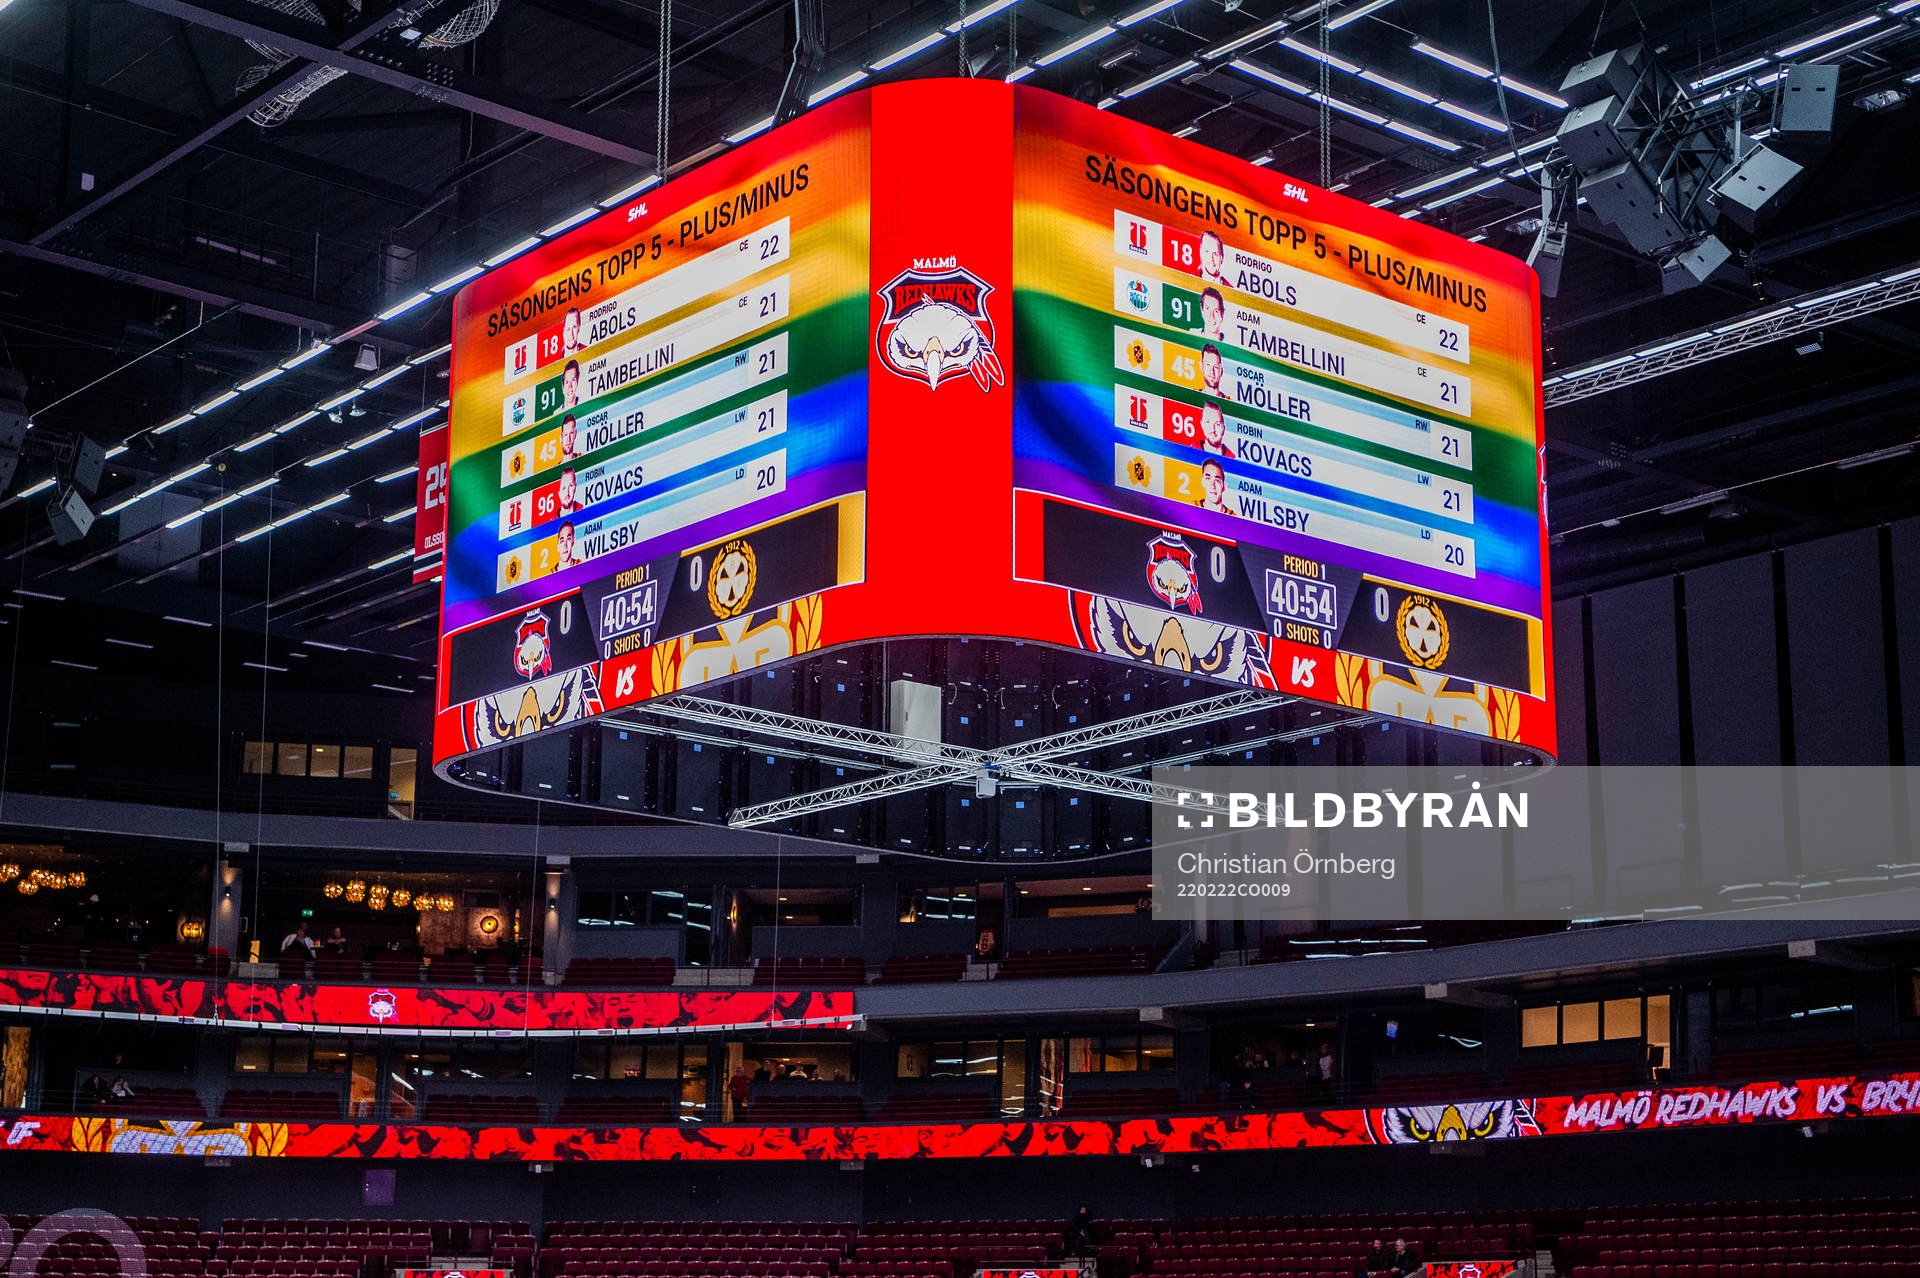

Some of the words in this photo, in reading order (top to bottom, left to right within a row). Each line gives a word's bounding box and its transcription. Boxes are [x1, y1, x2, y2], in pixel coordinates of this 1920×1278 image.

[1084, 155, 1238, 229] SÄSONGENS
[1244, 209, 1307, 251] TOPP
[1314, 235, 1327, 260] 5
[1348, 244, 1487, 312] PLUS/MINUS
[487, 268, 592, 337] SÄSONGENS
[596, 242, 646, 286] TOPP
[651, 234, 662, 260] 5
[679, 164, 809, 248] PLUS/MINUS
[739, 239, 749, 252] CE
[760, 235, 779, 260] 22
[1170, 239, 1193, 265] 18
[913, 256, 957, 269] MALMÖ
[1235, 254, 1272, 274] RODRIGO
[894, 283, 977, 315] REDHAWKS
[1237, 271, 1297, 306] ABOLS
[589, 301, 618, 321] RODRIGO
[738, 296, 748, 309] CE
[760, 292, 777, 317] 21
[1171, 297, 1192, 322] 91
[589, 307, 637, 345] ABOLS
[1236, 310, 1260, 326] ADAM
[1416, 313, 1427, 325] CE
[542, 336, 559, 358] 18
[1237, 325, 1345, 377] TAMBELLINI
[1439, 330, 1459, 352] 22
[588, 359, 607, 374] ADAM
[588, 344, 675, 397] TAMBELLINI
[735, 354, 747, 367] RW
[759, 349, 777, 375] 21
[1171, 356, 1195, 381] 45
[1237, 366, 1265, 383] OSCAR
[1417, 367, 1428, 378] CE
[540, 388, 557, 409] 91
[1237, 381, 1311, 422] MÖLLER
[1440, 382, 1458, 405] 21
[587, 411, 608, 427] OSCAR
[735, 410, 746, 423] LW
[758, 407, 776, 432] 21
[1171, 412, 1195, 437] 96
[1415, 419, 1428, 431] RW
[586, 411, 644, 451] MÖLLER
[1237, 423, 1263, 439] ROBIN
[539, 443, 557, 462] 45
[1237, 438, 1312, 478] KOVACS
[1441, 436, 1460, 458] 21
[585, 466, 605, 481] ROBIN
[735, 469, 745, 480] LD
[757, 465, 776, 490] 20
[1178, 472, 1190, 495] 2
[1417, 474, 1429, 486] LW
[585, 467, 643, 506] KOVACS
[1238, 480, 1263, 496] ADAM
[538, 495, 554, 517] 96
[1443, 489, 1461, 512] 21
[1238, 497, 1309, 533] WILSBY
[584, 521, 603, 536] ADAM
[1420, 529, 1431, 541] LD
[424, 533, 445, 549] OLSSO
[583, 522, 639, 559] WILSBY
[725, 541, 741, 554] 1912
[540, 548, 549, 568] 2
[1210, 546, 1226, 583] 0
[1444, 544, 1464, 567] 20
[615, 566, 644, 589] PERIOD
[645, 565, 650, 580] 1
[690, 556, 703, 591] 0
[1283, 555, 1319, 577] PERIOD
[1320, 564, 1326, 580] 1
[1270, 576, 1333, 622] 40:54
[1375, 587, 1389, 623] 0
[1413, 595, 1430, 607] 1912
[560, 600, 572, 635] 0
[604, 596, 654, 634] 40:54
[604, 641, 611, 660] 0
[614, 632, 641, 656] SHOTS
[643, 628, 650, 647] 0
[1273, 618, 1282, 639] 0
[1286, 623, 1319, 646] SHOTS
[1323, 629, 1332, 649] 0
[615, 665, 635, 699] VS
[1291, 656, 1316, 688] VS
[1564, 1091, 1652, 1128] MALMÖ
[1655, 1087, 1798, 1125] REDHAWKS
[1816, 1084, 1848, 1114] VS
[1862, 1079, 1920, 1113] BRY
